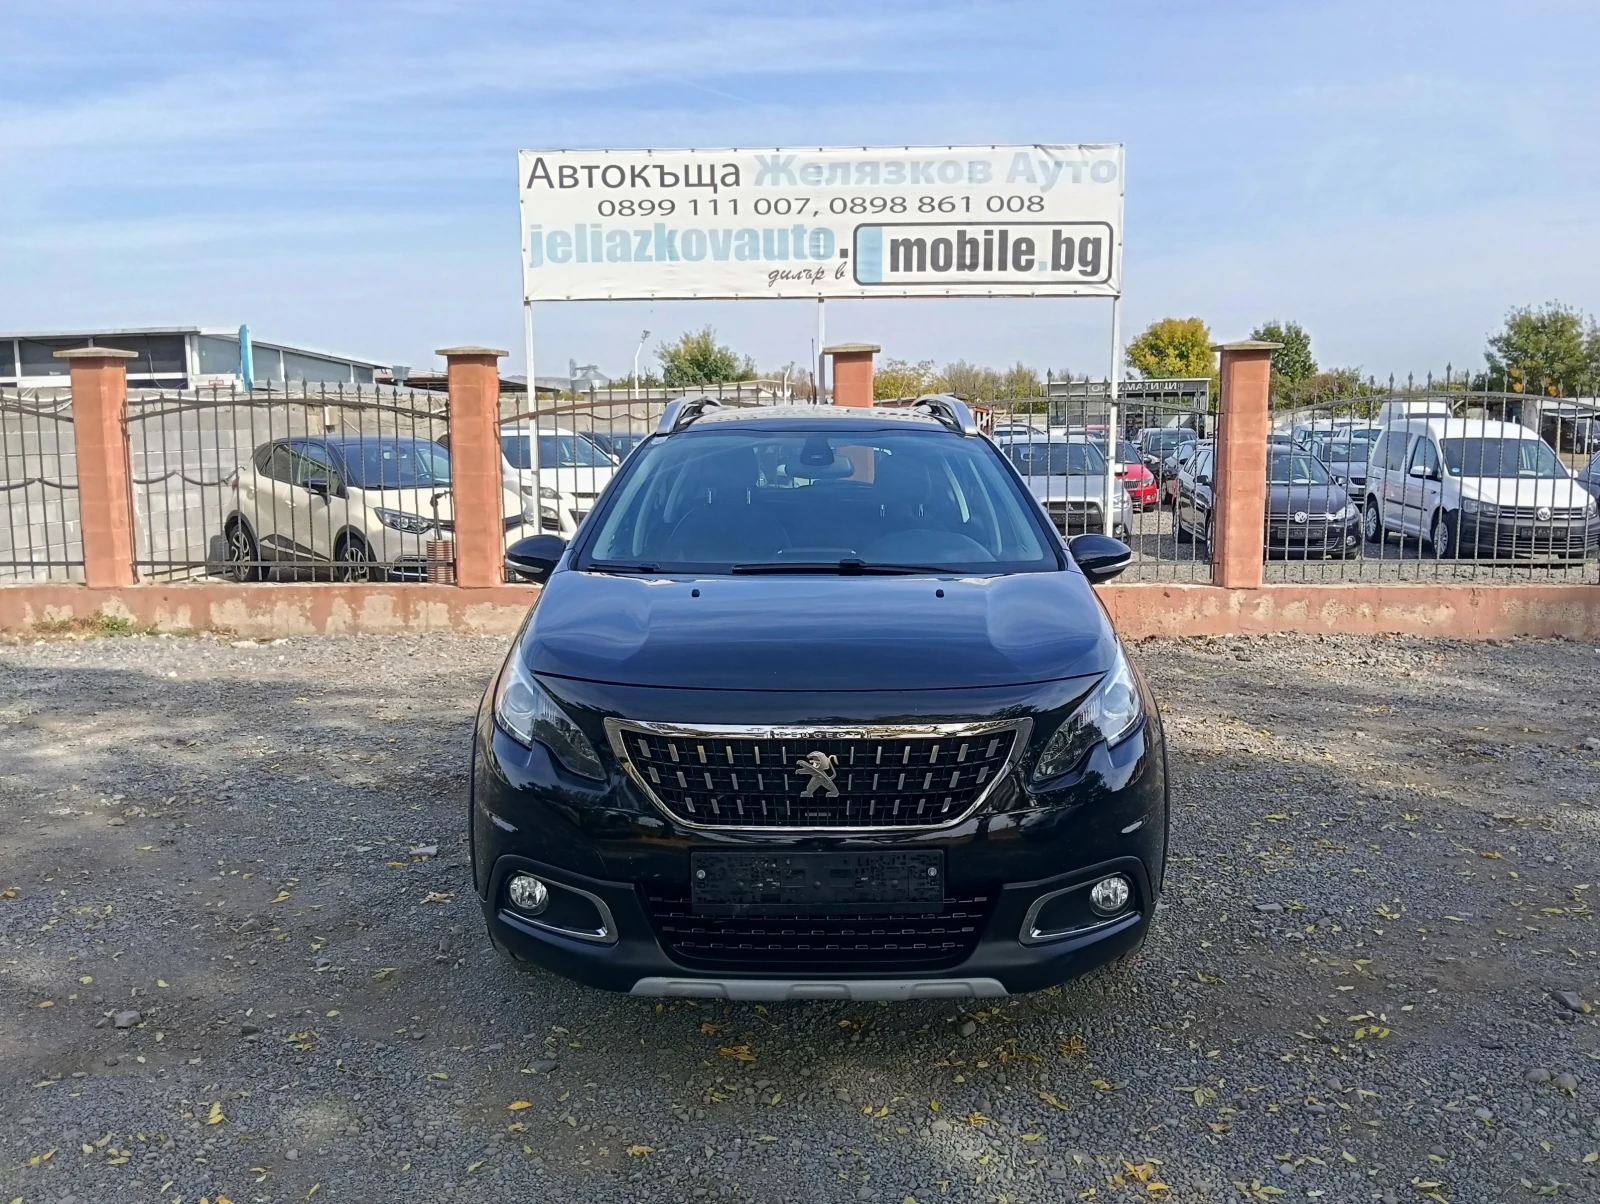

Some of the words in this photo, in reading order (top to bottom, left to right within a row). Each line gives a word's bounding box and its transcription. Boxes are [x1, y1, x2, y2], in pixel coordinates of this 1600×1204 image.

[526, 157, 740, 194] Автокъща
[753, 154, 993, 187] Желязков
[1005, 152, 1118, 193] Ауто
[597, 198, 676, 217] 0899
[688, 198, 739, 216] 111
[753, 197, 819, 218] 007,
[829, 196, 908, 215] 0898
[917, 195, 971, 214] 861
[986, 195, 1045, 213] 008
[890, 229, 1103, 277] mobile.bg
[768, 266, 826, 288] дилър
[834, 260, 848, 280] в
[778, 731, 859, 739] PEUGEOT
